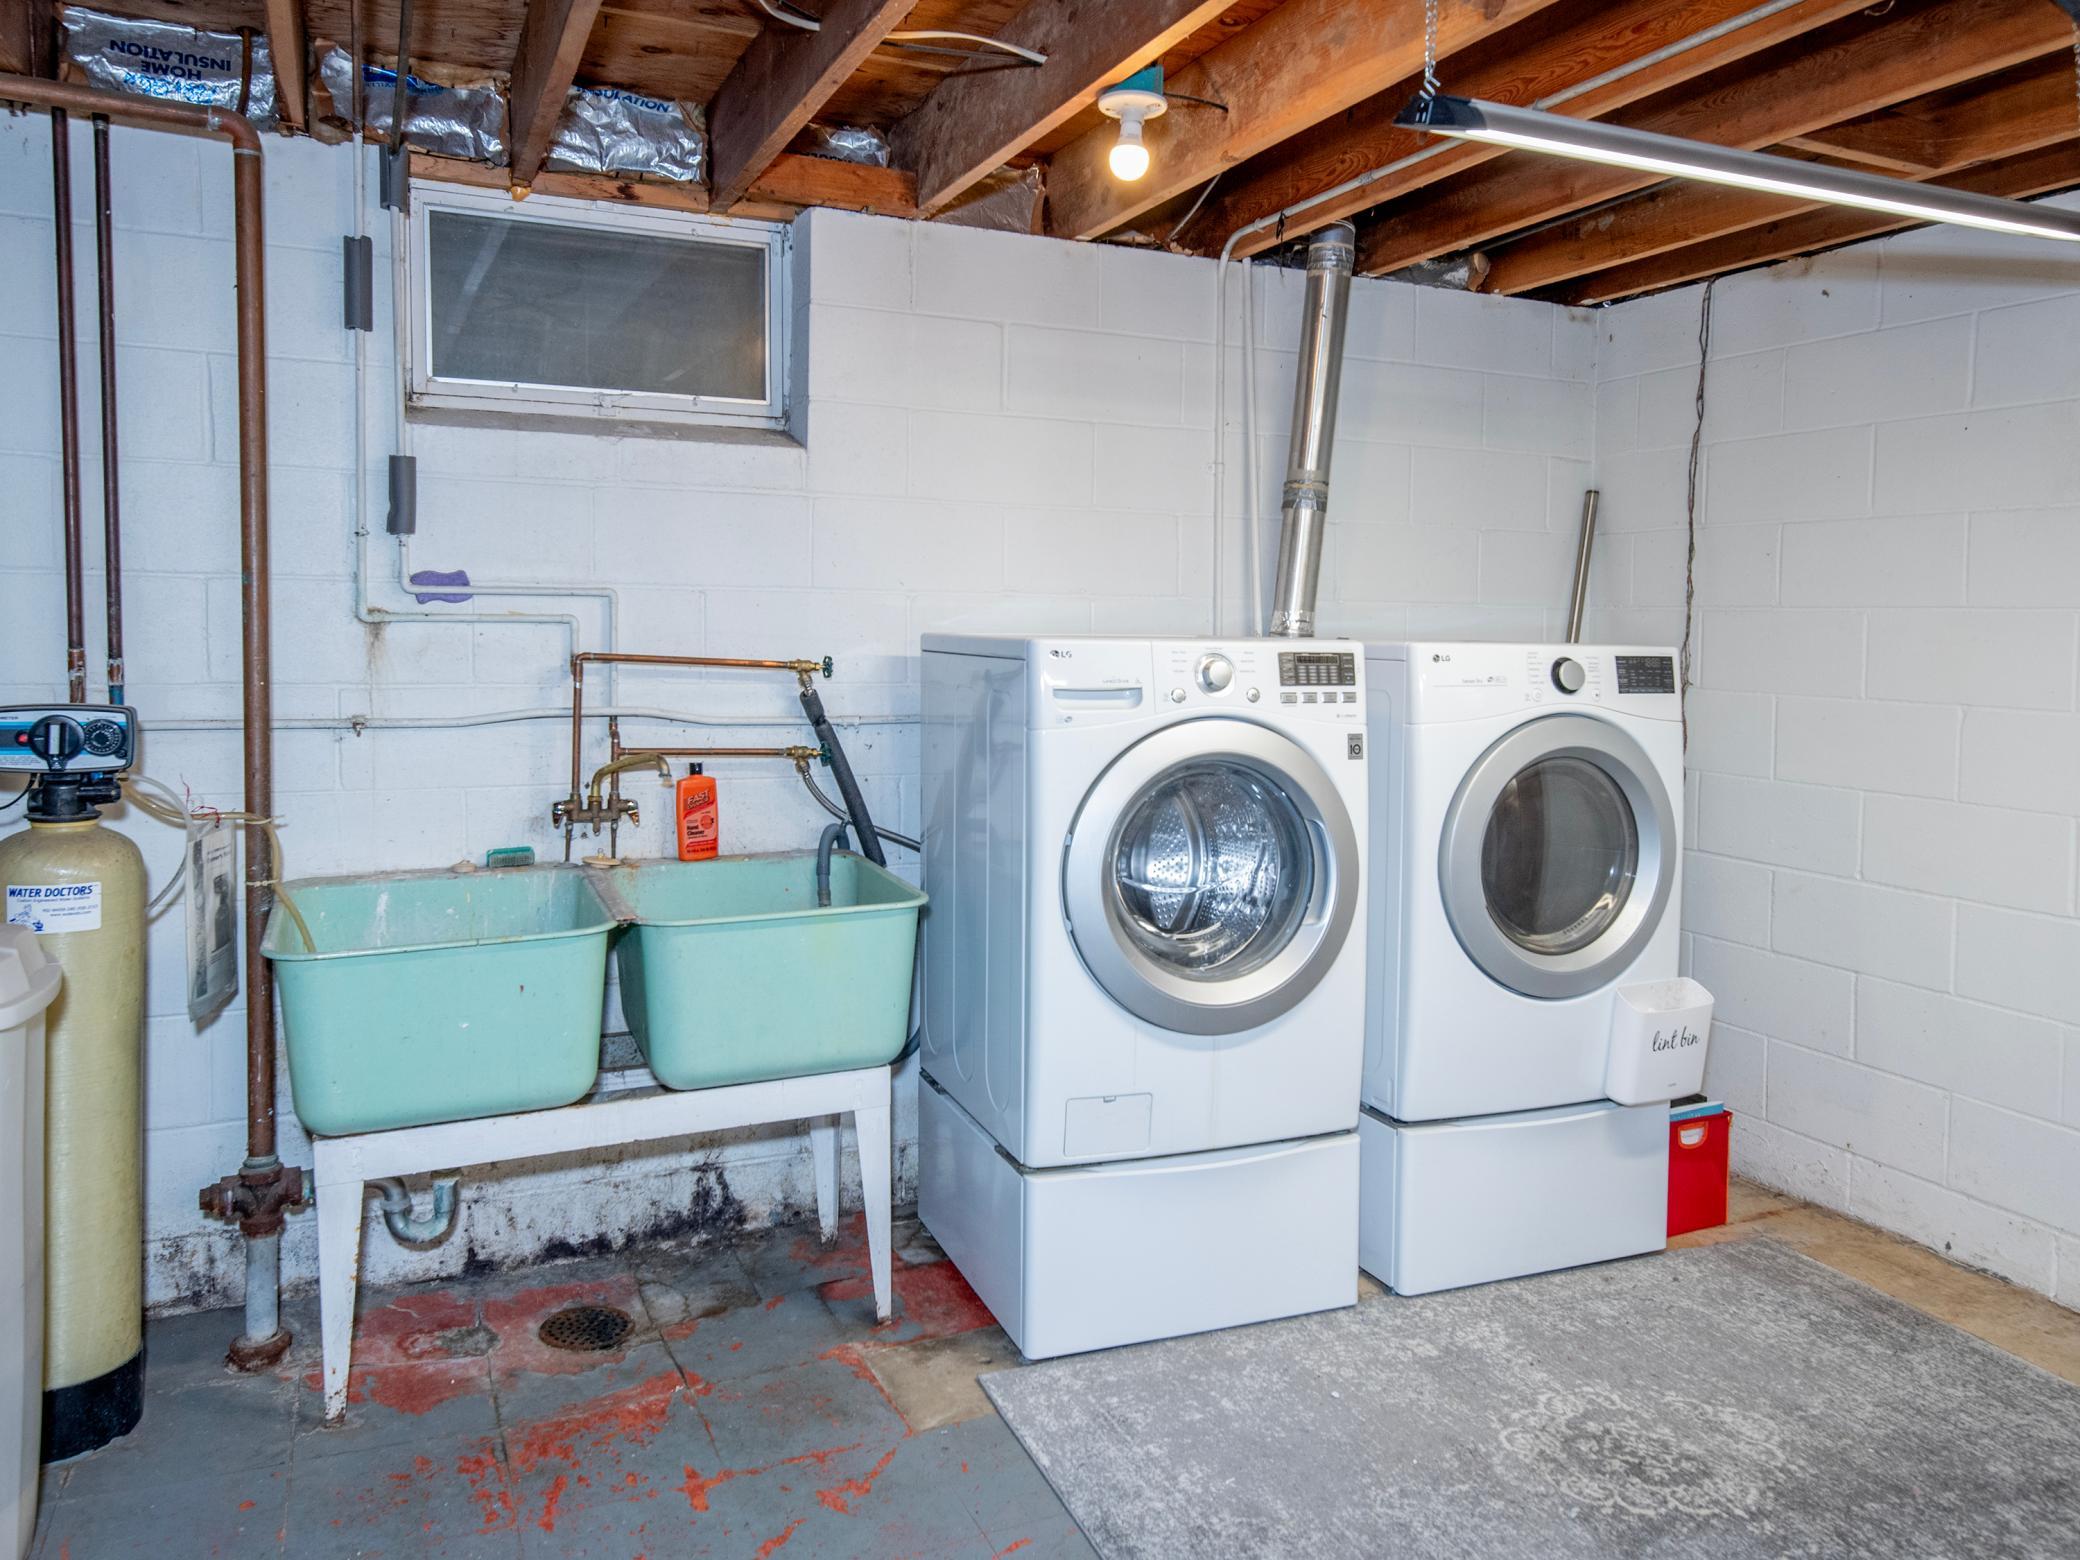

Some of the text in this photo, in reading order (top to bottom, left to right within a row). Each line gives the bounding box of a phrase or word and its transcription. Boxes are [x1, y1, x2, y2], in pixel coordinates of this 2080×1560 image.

[110, 40, 231, 71] INSULATION
[141, 60, 202, 80] HOME
[9, 885, 93, 898] WATER DOCTORS
[1652, 1026, 1699, 1052] lint bin
